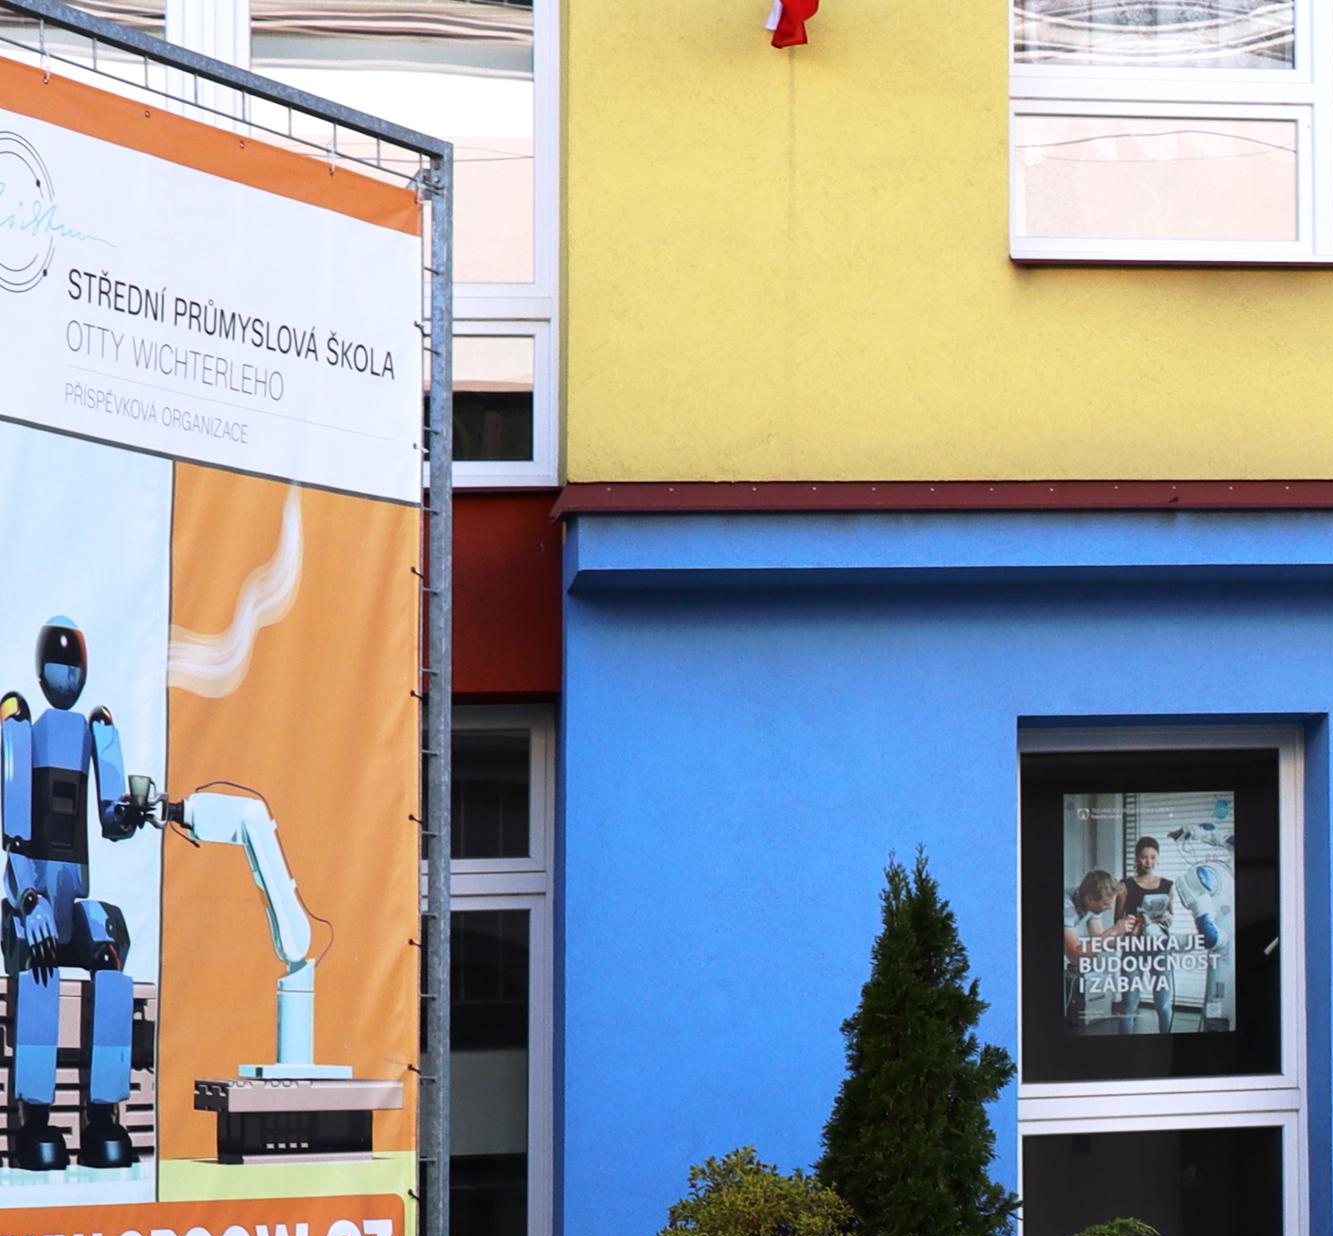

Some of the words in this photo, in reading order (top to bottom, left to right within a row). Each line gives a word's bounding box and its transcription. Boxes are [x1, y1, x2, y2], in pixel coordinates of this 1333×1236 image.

[68, 268, 166, 323] STŘEDNÍ
[174, 298, 318, 362] PRŮMYSLOVÁ
[326, 331, 395, 380] ŠKOLA
[66, 320, 124, 362] OTTY
[132, 335, 284, 401] WICHTERLEHO
[65, 382, 157, 424] PŘÍSPĚVKOVÁ
[162, 406, 248, 445] ORGANIZACE
[1079, 935, 1179, 953] TECHNIKA
[1184, 934, 1205, 950] JE
[1079, 954, 1220, 973] BUDOUCNOST
[1079, 977, 1084, 993] I
[1089, 974, 1170, 993] ZÁBAVA
